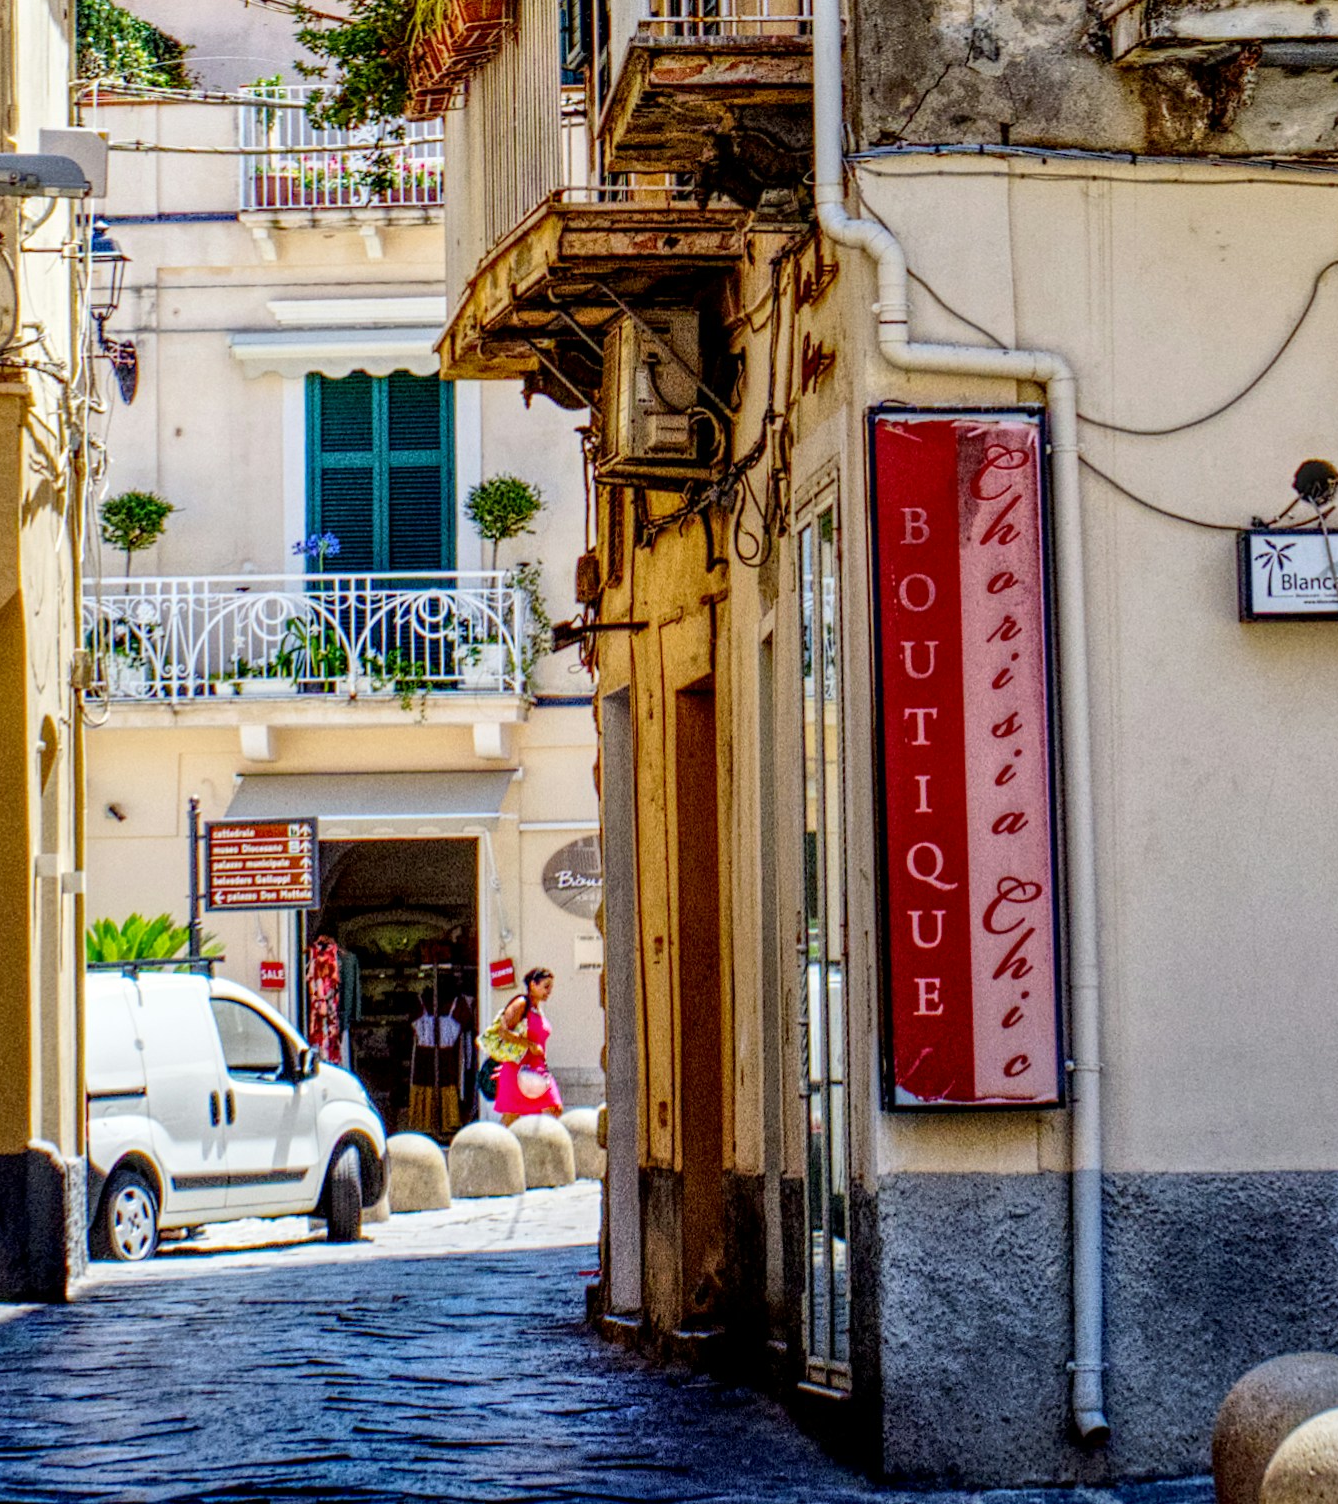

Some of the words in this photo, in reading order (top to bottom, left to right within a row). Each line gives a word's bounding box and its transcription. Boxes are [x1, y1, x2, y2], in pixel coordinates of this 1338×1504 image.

[970, 444, 1030, 836] Chorisia
[897, 506, 959, 1018] BOUTIQUE
[212, 828, 256, 839] cattedrale
[212, 846, 239, 855] museo
[241, 843, 283, 854] Diocesano
[212, 860, 244, 872] palazzo
[245, 858, 290, 869] municipale
[226, 892, 258, 903] palazzo
[260, 969, 286, 980] SALE
[982, 876, 1042, 1079] Chic
